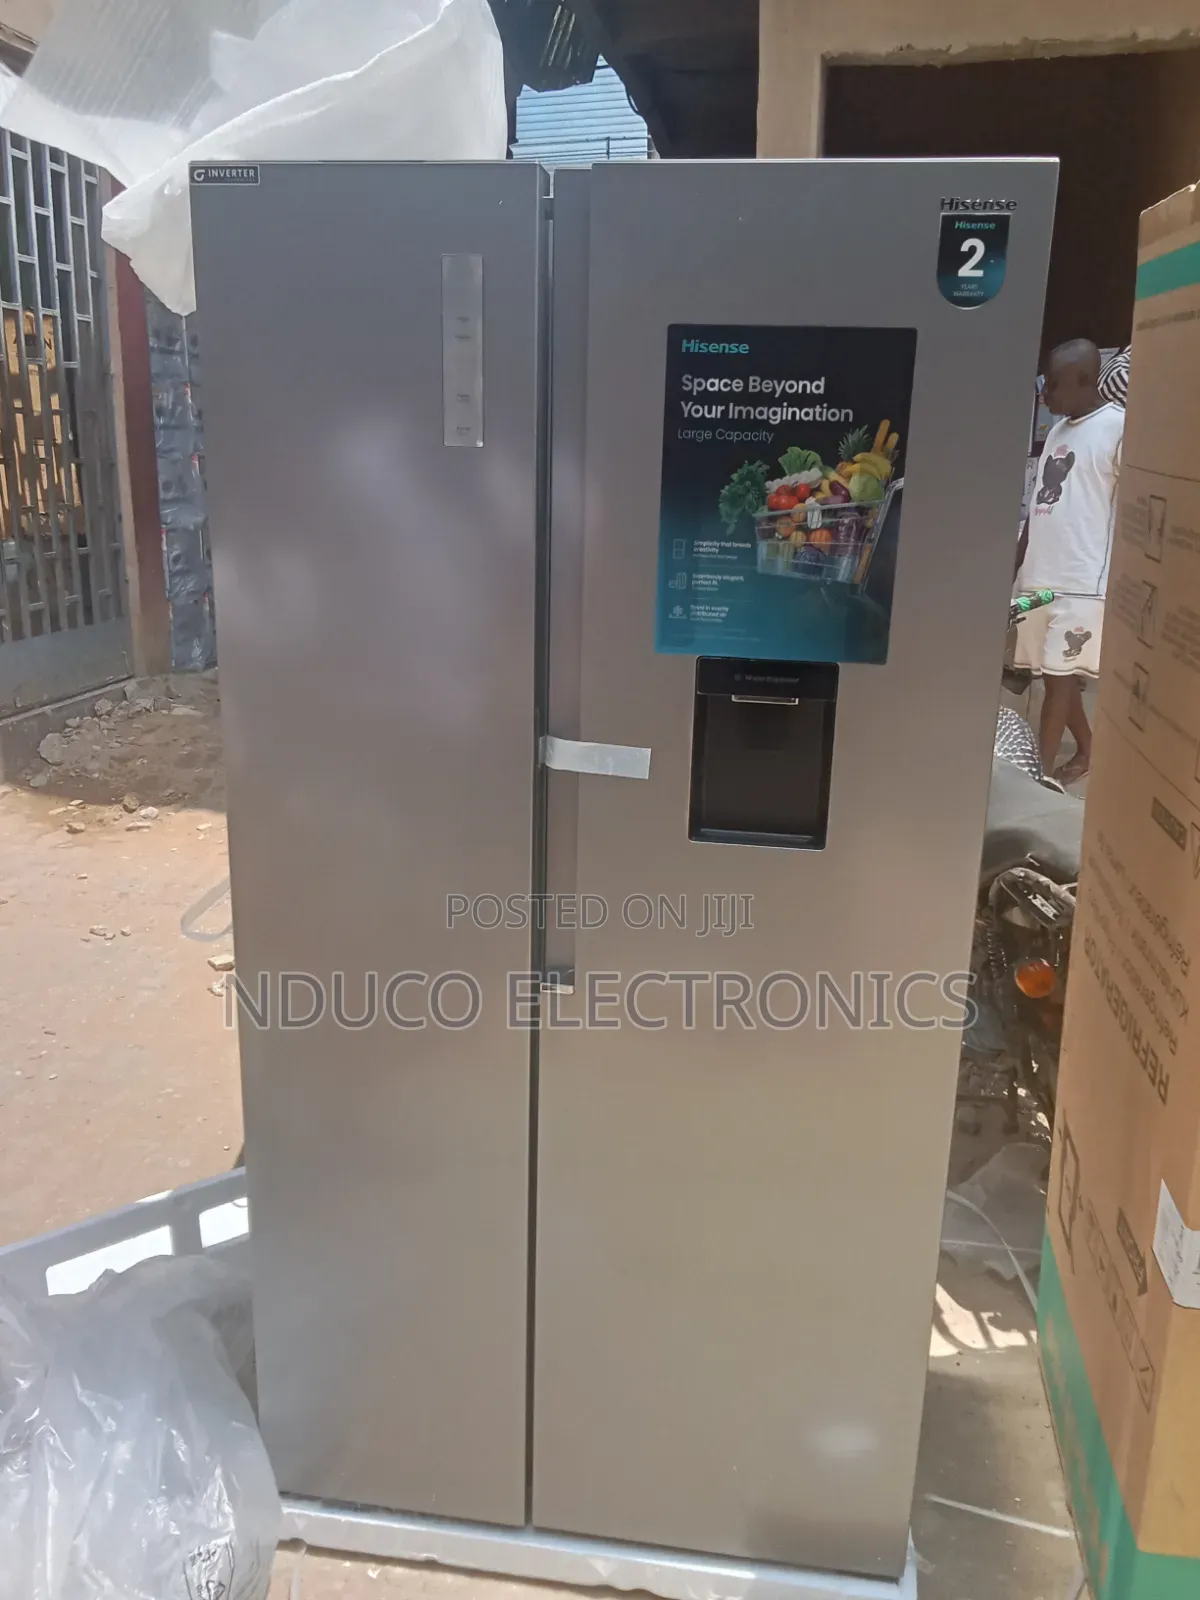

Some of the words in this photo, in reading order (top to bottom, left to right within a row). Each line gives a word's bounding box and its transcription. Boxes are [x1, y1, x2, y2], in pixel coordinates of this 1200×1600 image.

[208, 169, 255, 178] INVERTER
[940, 196, 1017, 211] Hisense
[954, 220, 996, 229] Hisense
[957, 238, 986, 278] 2
[681, 339, 750, 354] Hisense
[681, 374, 744, 396] Space
[748, 375, 826, 398] Beyond
[680, 401, 726, 420] Your
[728, 402, 854, 425] Imagination
[677, 428, 713, 442] Large
[715, 428, 775, 444] Capacity
[693, 540, 720, 548] Simplicity
[1084, 924, 1170, 1106] REFRIGERATOR
